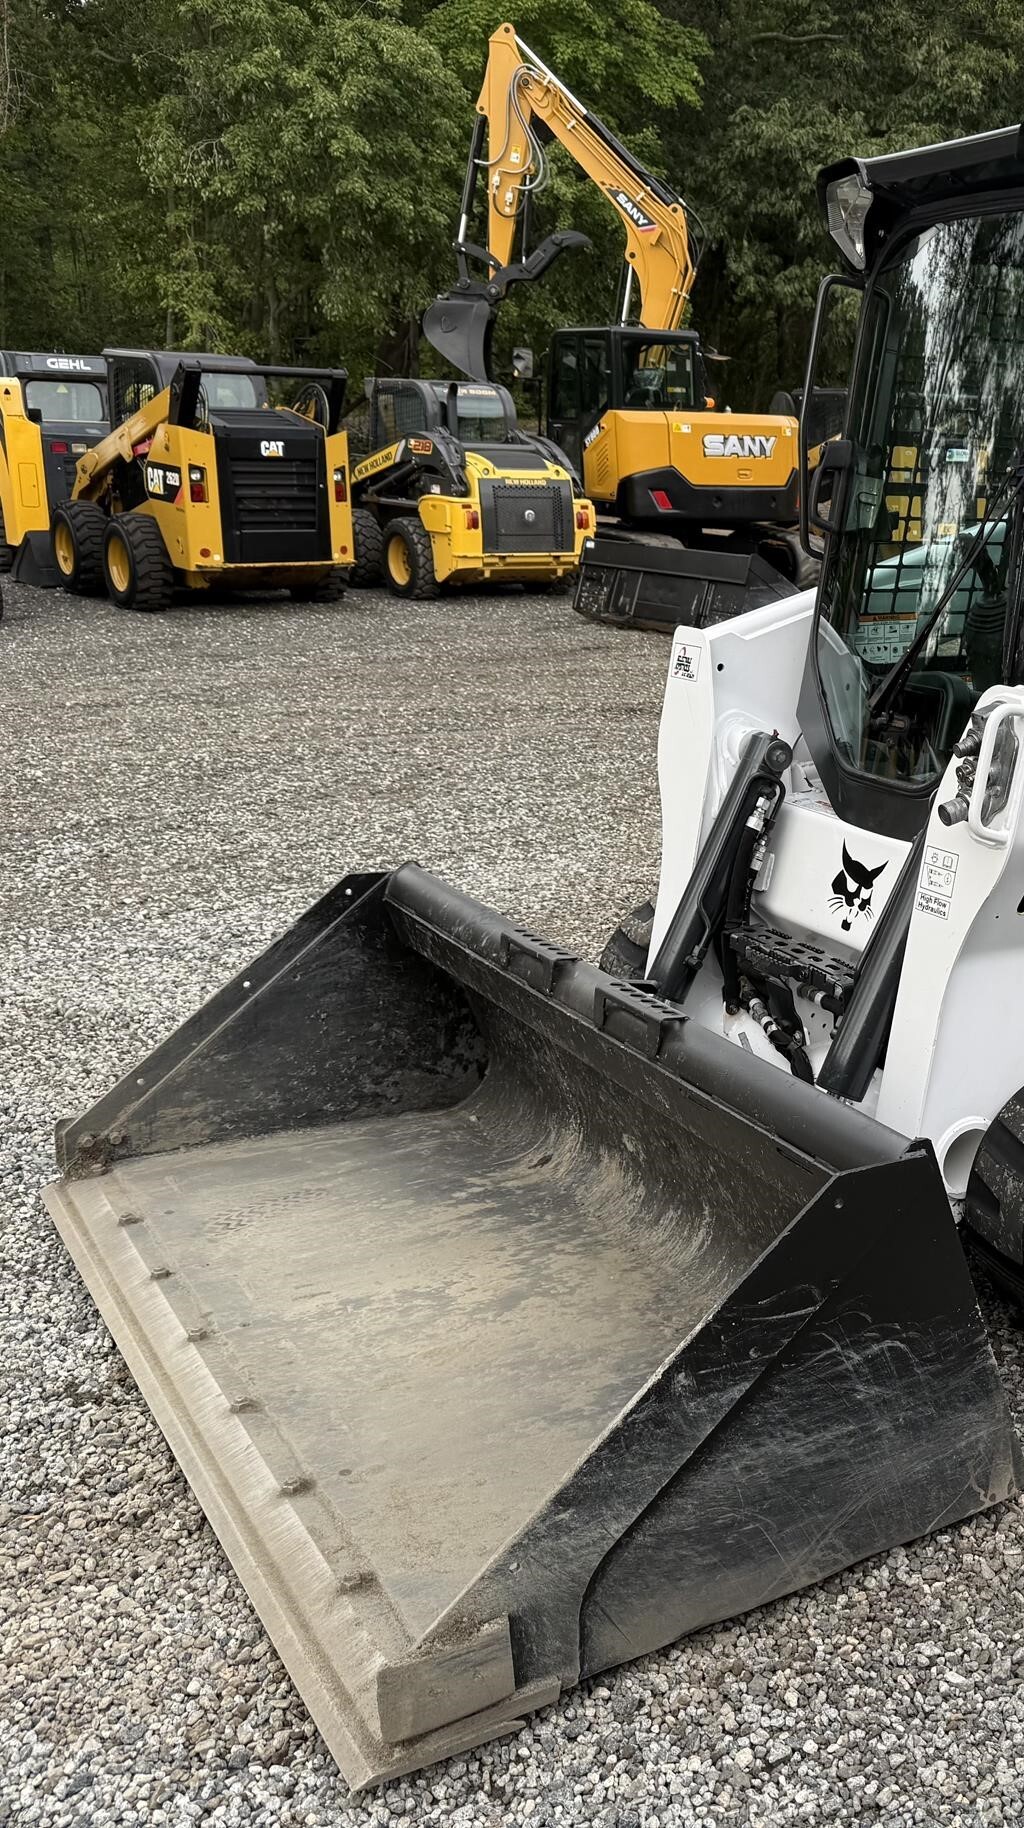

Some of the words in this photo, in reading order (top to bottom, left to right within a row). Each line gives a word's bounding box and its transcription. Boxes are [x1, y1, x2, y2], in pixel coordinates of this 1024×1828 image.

[616, 193, 649, 225] SANY
[46, 358, 91, 370] GEHL
[260, 440, 285, 457] CAT
[703, 433, 777, 458] SANY
[357, 465, 369, 477] NEW
[368, 452, 393, 470] HOLLAND
[147, 467, 164, 495] CAT
[917, 901, 946, 917] Hydraulics
[920, 892, 933, 904] High
[933, 897, 948, 908] Flow
